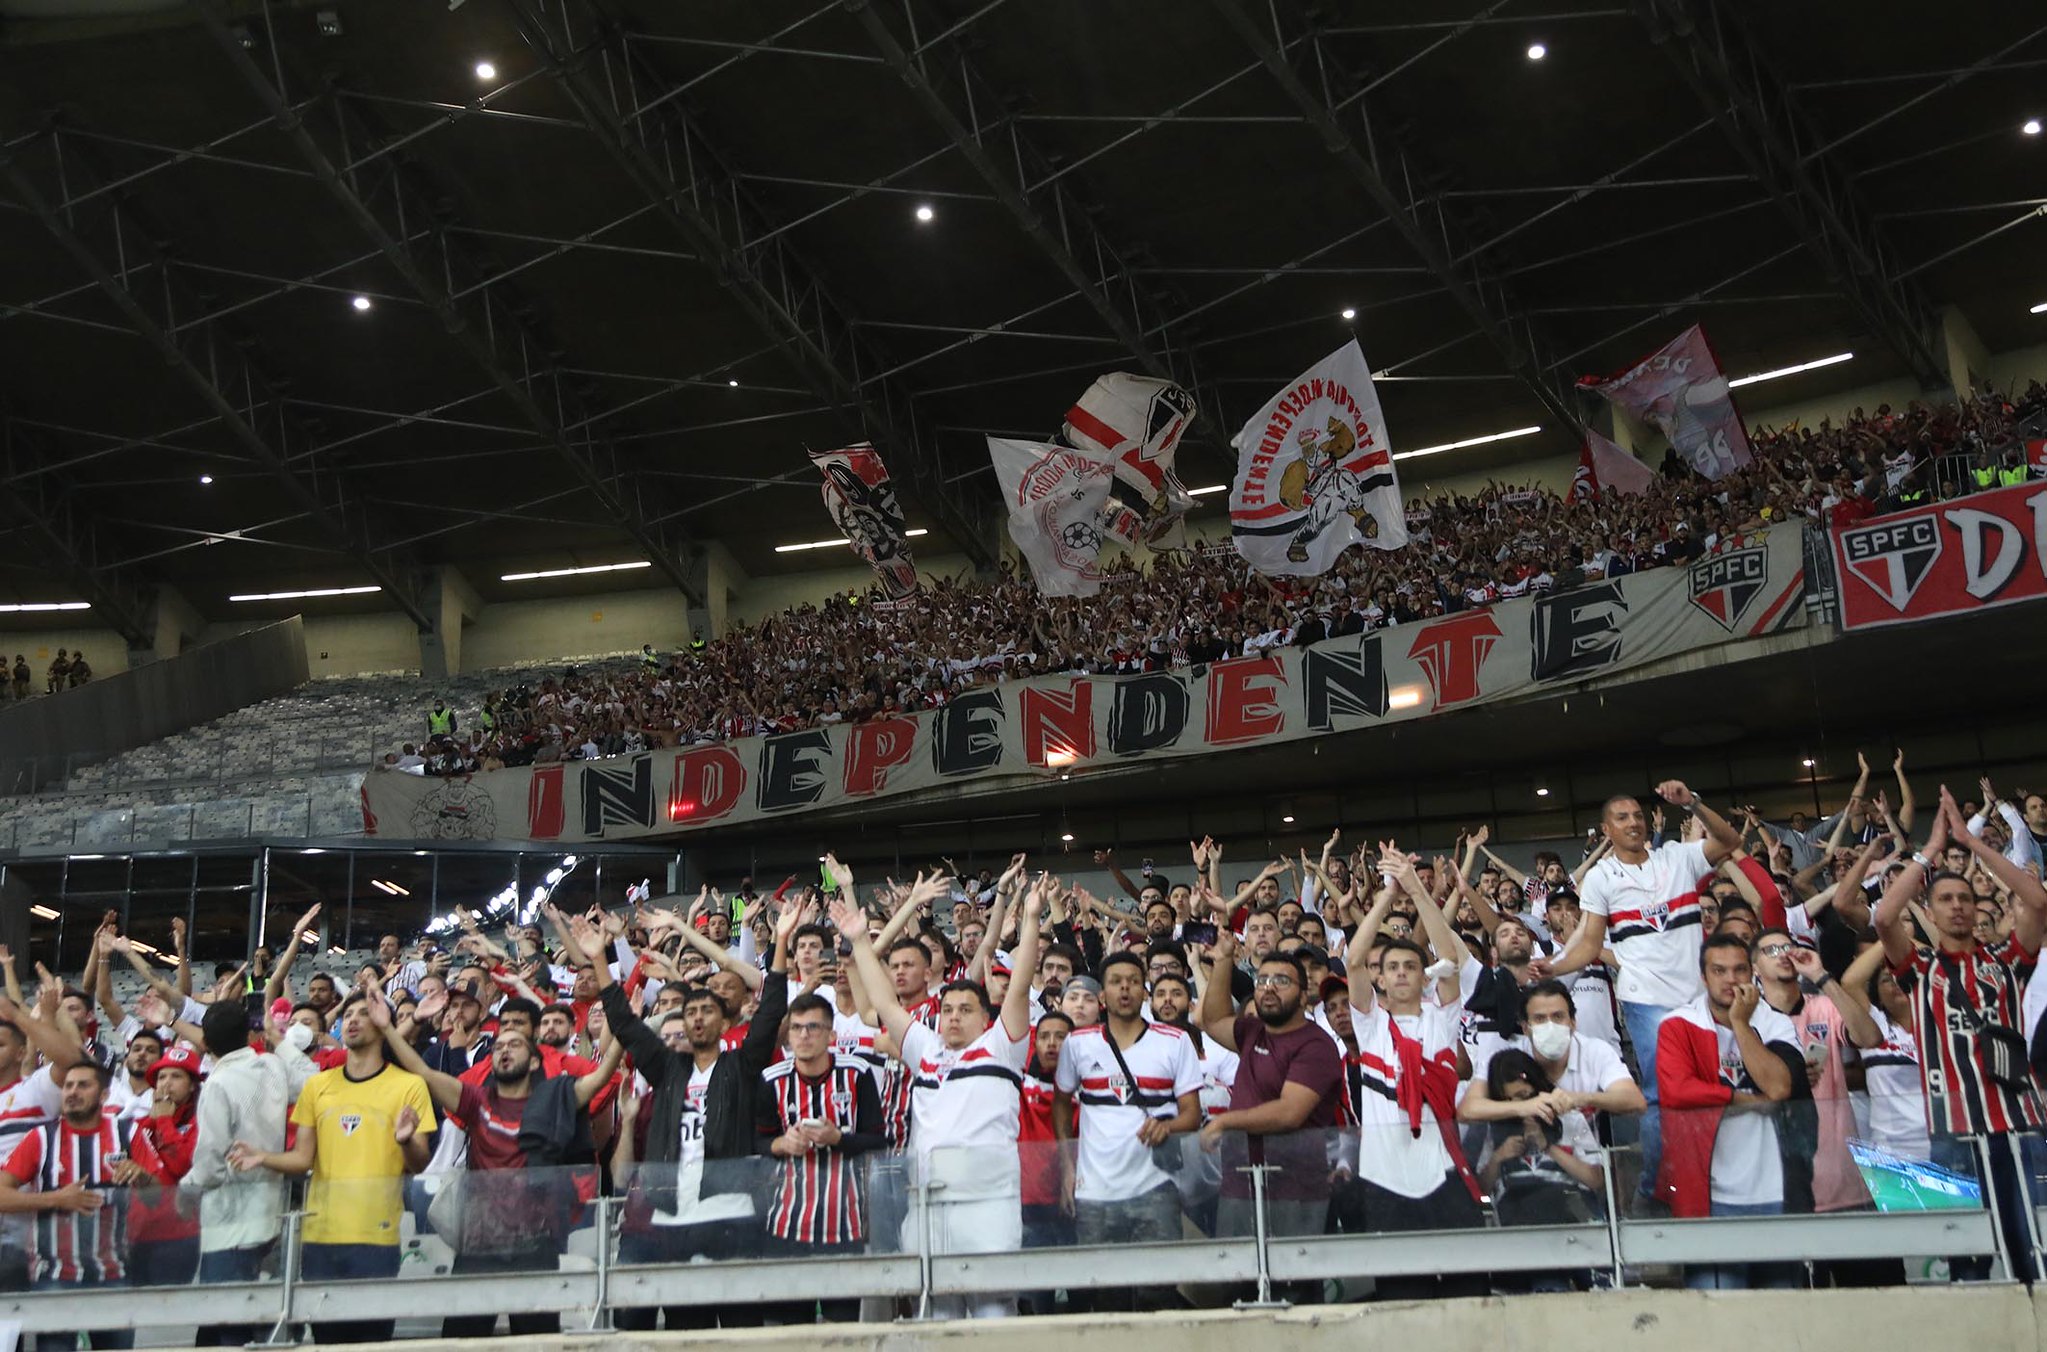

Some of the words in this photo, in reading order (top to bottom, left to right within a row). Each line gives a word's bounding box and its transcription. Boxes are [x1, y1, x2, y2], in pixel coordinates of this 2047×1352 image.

[1852, 523, 1931, 557] SPFC
[1694, 554, 1761, 591] SPFC
[527, 578, 1628, 840] INDEPENDENTE
